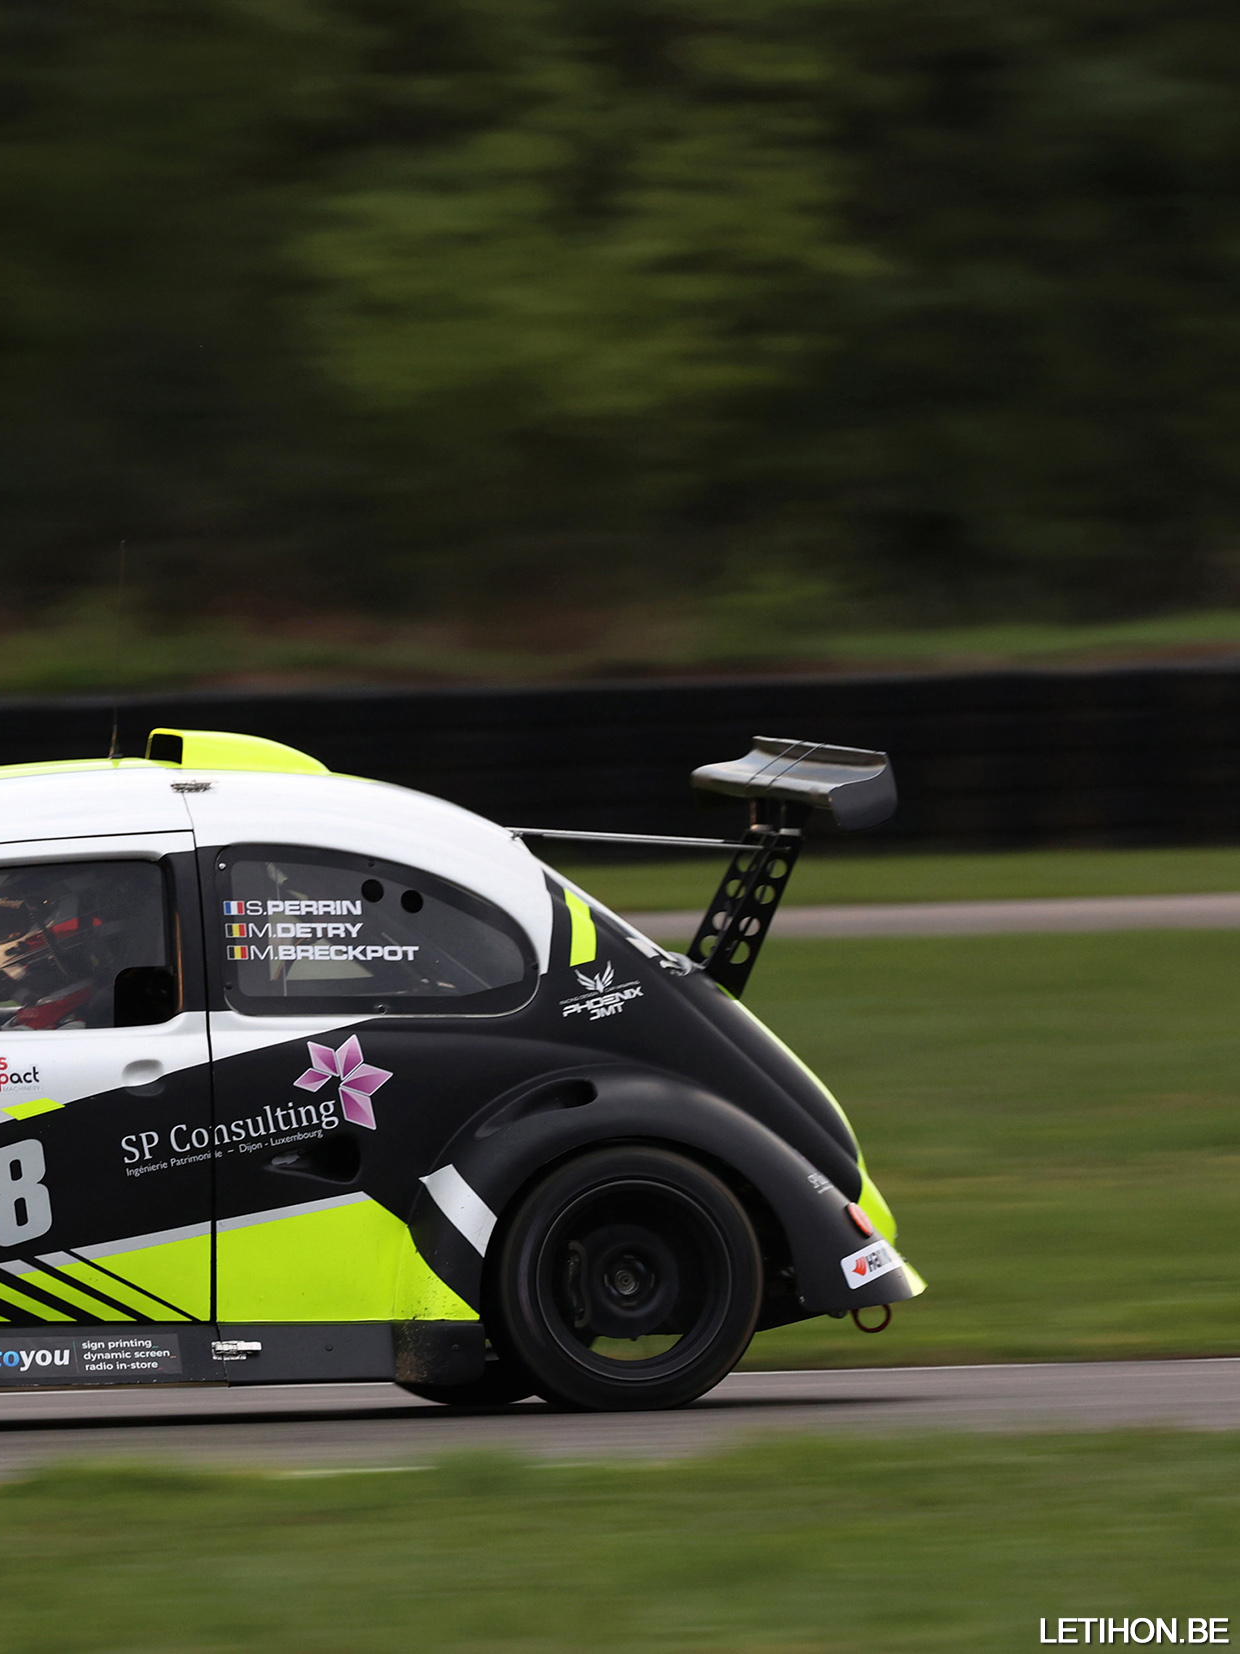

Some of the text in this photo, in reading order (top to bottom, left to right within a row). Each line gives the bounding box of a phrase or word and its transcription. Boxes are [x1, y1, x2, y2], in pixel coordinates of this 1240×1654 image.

[246, 899, 362, 916] S.PERRIN
[248, 922, 363, 938] M.DETRY
[250, 945, 420, 961] M.BRECKPOT
[562, 986, 644, 1017] PHOENIX
[589, 1001, 625, 1020] JMT
[120, 1099, 340, 1164] SP Consulting
[125, 1160, 168, 1177] Ingénierie
[239, 1141, 263, 1154] Dijon
[270, 1128, 323, 1147] Luxembourg
[81, 1340, 105, 1350] sign
[83, 1350, 131, 1361] dynamic
[85, 1362, 114, 1371] radio
